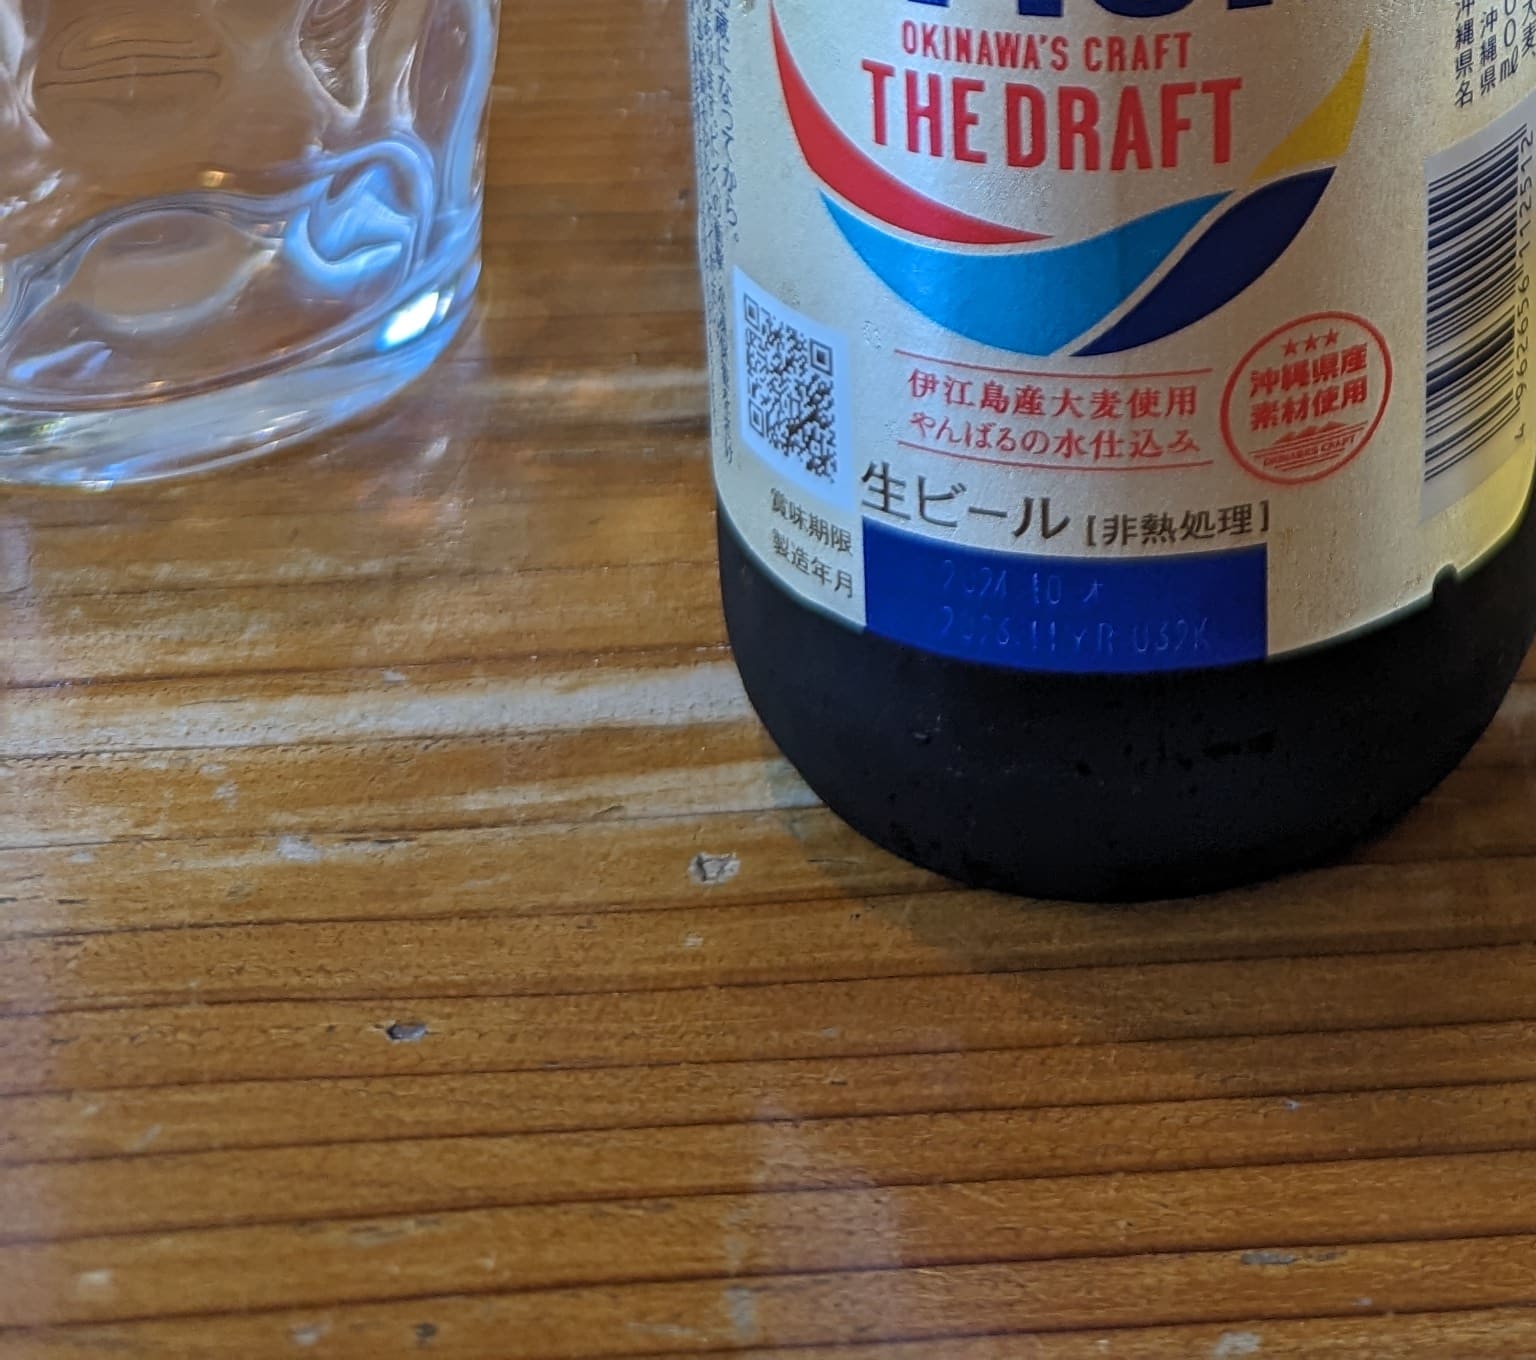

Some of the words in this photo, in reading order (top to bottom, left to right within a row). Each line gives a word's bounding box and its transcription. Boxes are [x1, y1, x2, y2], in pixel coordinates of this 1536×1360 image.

[901, 19, 1069, 72] OKINAWA'S
[1083, 31, 1193, 73] CRAFT
[1479, 6, 1498, 98] 沖縄県
[861, 57, 988, 165] THE
[1004, 76, 1243, 172] DRAFT
[908, 368, 1198, 423] 伊江島産大麦使用
[1250, 342, 1368, 398] 沖縄県産
[1251, 375, 1368, 431] 素材使用
[909, 410, 1201, 461] やんばるの水仕込み
[769, 486, 853, 558] 賞味期限
[861, 461, 1070, 541] 生ビール
[772, 527, 854, 599] 製造年月
